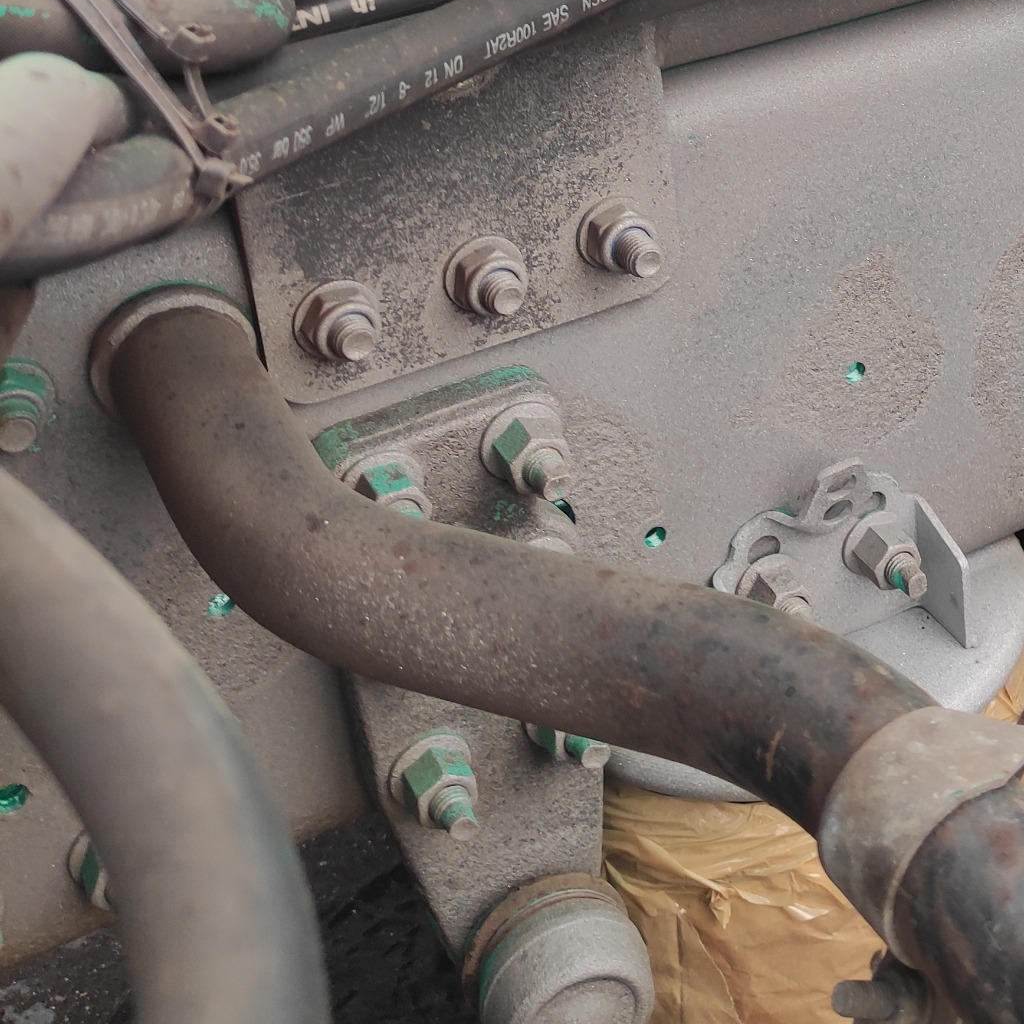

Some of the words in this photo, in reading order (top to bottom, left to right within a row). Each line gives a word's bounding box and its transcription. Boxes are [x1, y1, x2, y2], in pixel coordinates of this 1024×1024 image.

[541, 4, 570, 32] SAE
[483, 20, 537, 61] 100R2AT
[424, 67, 439, 89] 12
[443, 55, 464, 80] DN
[325, 112, 346, 138] WP
